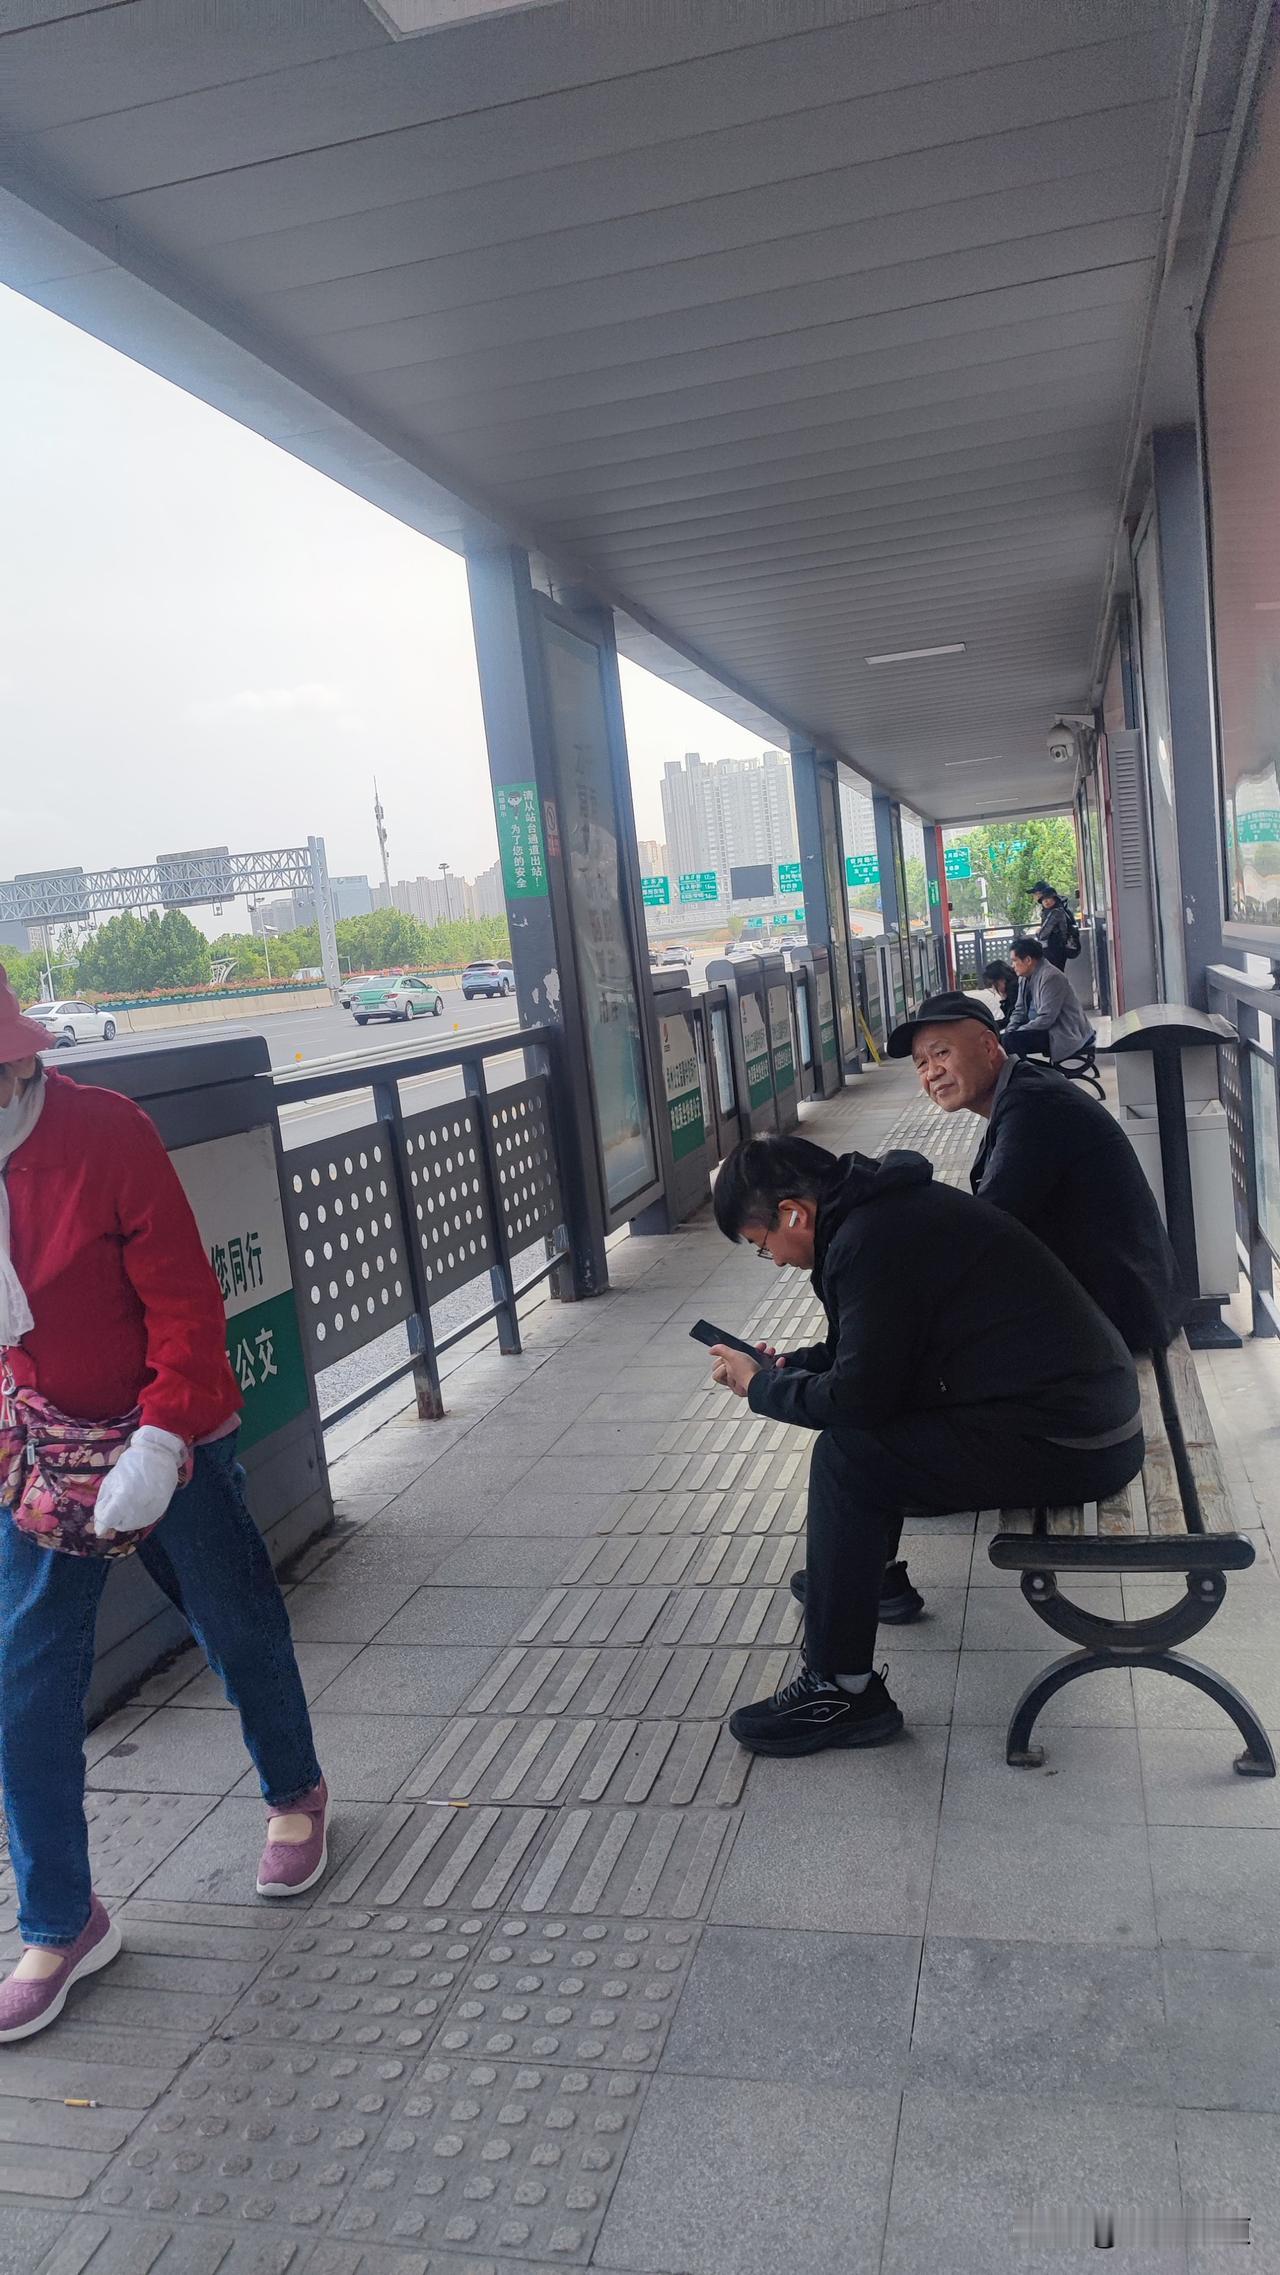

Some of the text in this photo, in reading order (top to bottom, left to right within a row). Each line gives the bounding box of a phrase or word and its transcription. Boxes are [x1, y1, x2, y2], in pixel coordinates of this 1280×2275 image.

[511, 824, 527, 889] 为了您的安全
[211, 1232, 264, 1301] 您同行
